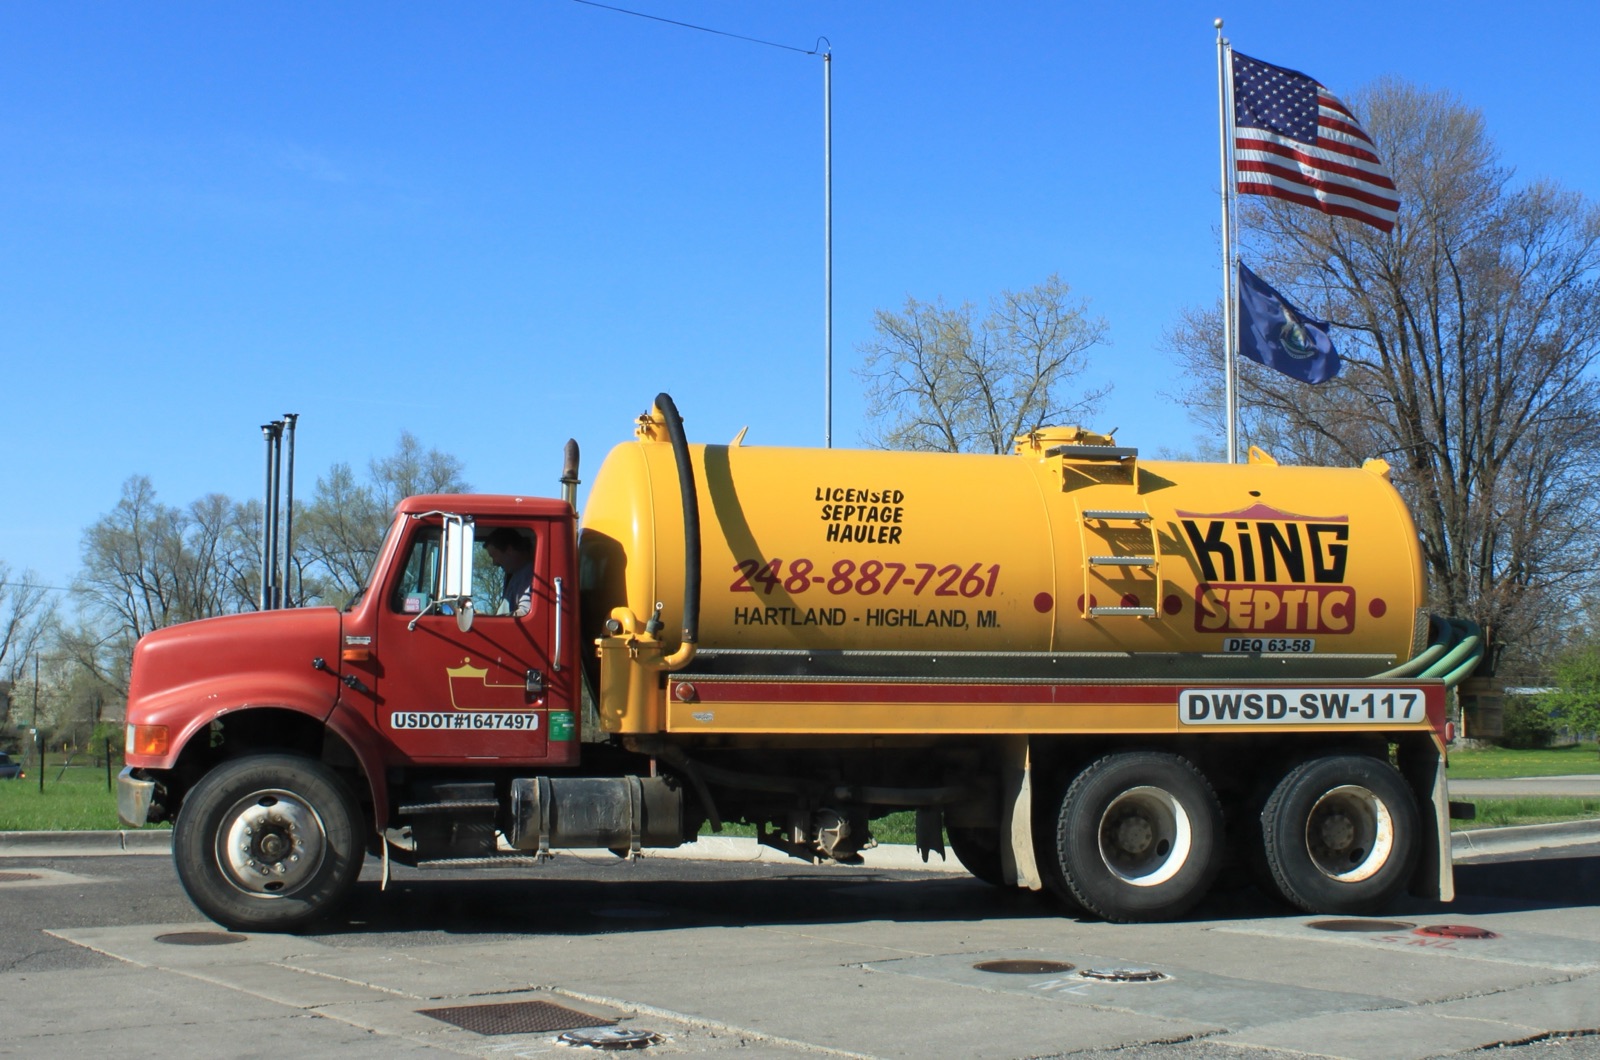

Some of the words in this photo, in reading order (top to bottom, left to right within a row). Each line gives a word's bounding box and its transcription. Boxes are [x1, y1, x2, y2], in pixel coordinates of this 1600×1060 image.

[815, 487, 904, 504] LICENSED
[820, 504, 904, 523] SEPTAGE
[826, 523, 902, 544] HAULER
[729, 558, 1000, 598] 248-887-7261
[734, 607, 847, 626] HARTLAND
[866, 608, 970, 630] HIGHLAND,
[976, 610, 1001, 628] MI.
[1201, 588, 1350, 631] SEPTIC
[1229, 639, 1263, 653] DEQ
[1267, 639, 1311, 652] 63-58
[1188, 693, 1418, 720] DWSD-SW-117
[394, 713, 535, 729] USDOT#1647497
